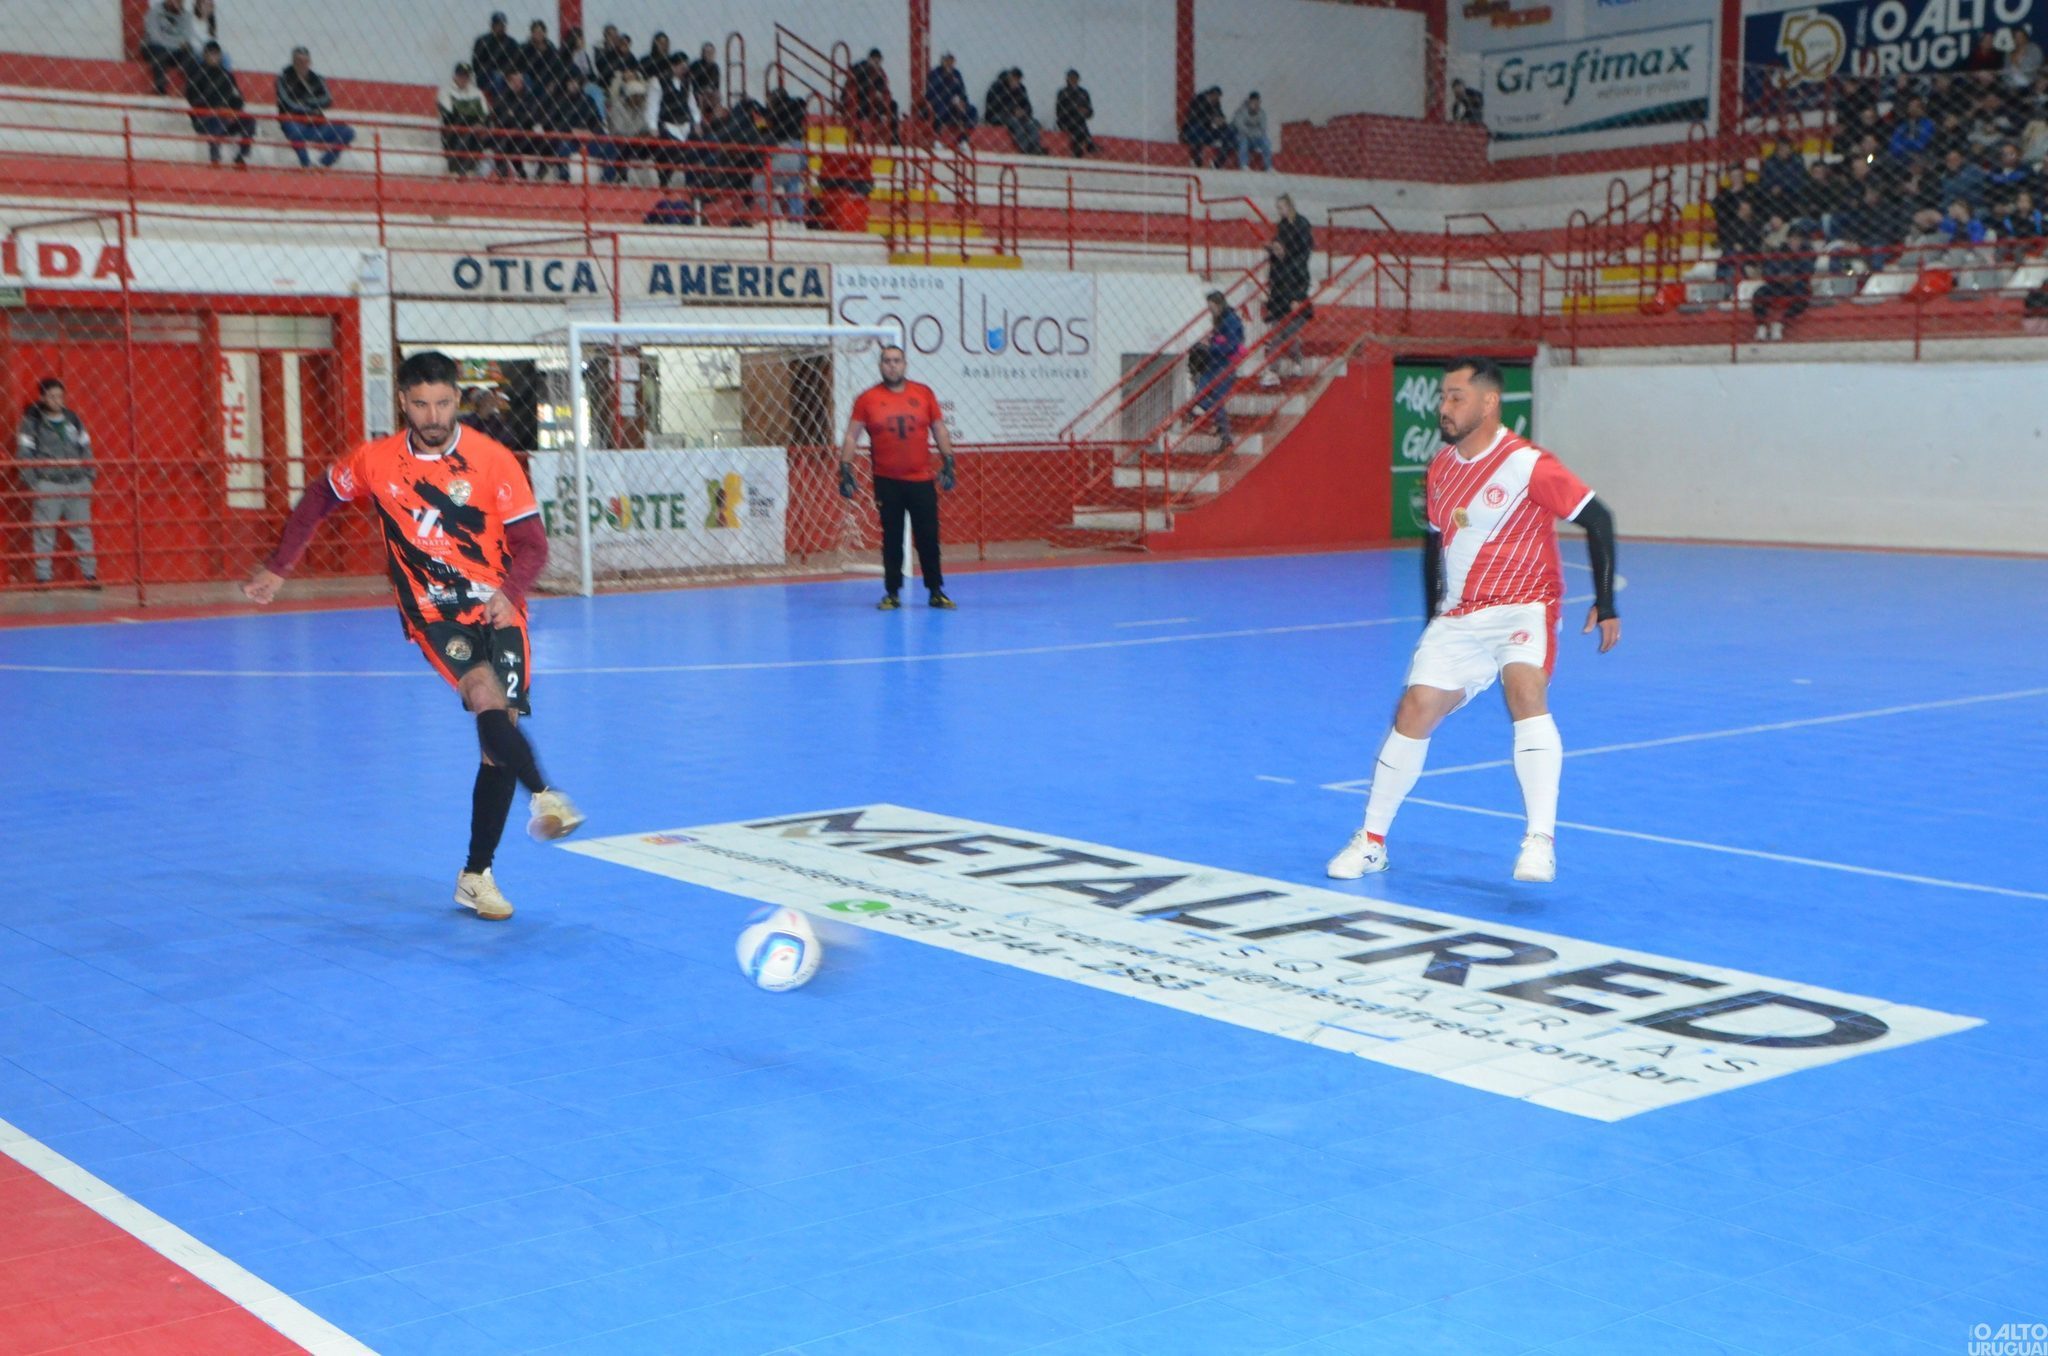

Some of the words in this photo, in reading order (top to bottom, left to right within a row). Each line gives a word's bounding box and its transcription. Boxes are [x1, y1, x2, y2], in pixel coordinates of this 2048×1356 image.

[1871, 1, 1907, 41] O
[1496, 44, 1694, 106] Grafimax
[836, 271, 945, 291] Laboratório
[507, 671, 519, 698] 2
[741, 810, 1890, 1050] METALFRED
[1170, 937, 1759, 1074] ESQUADRIAS
